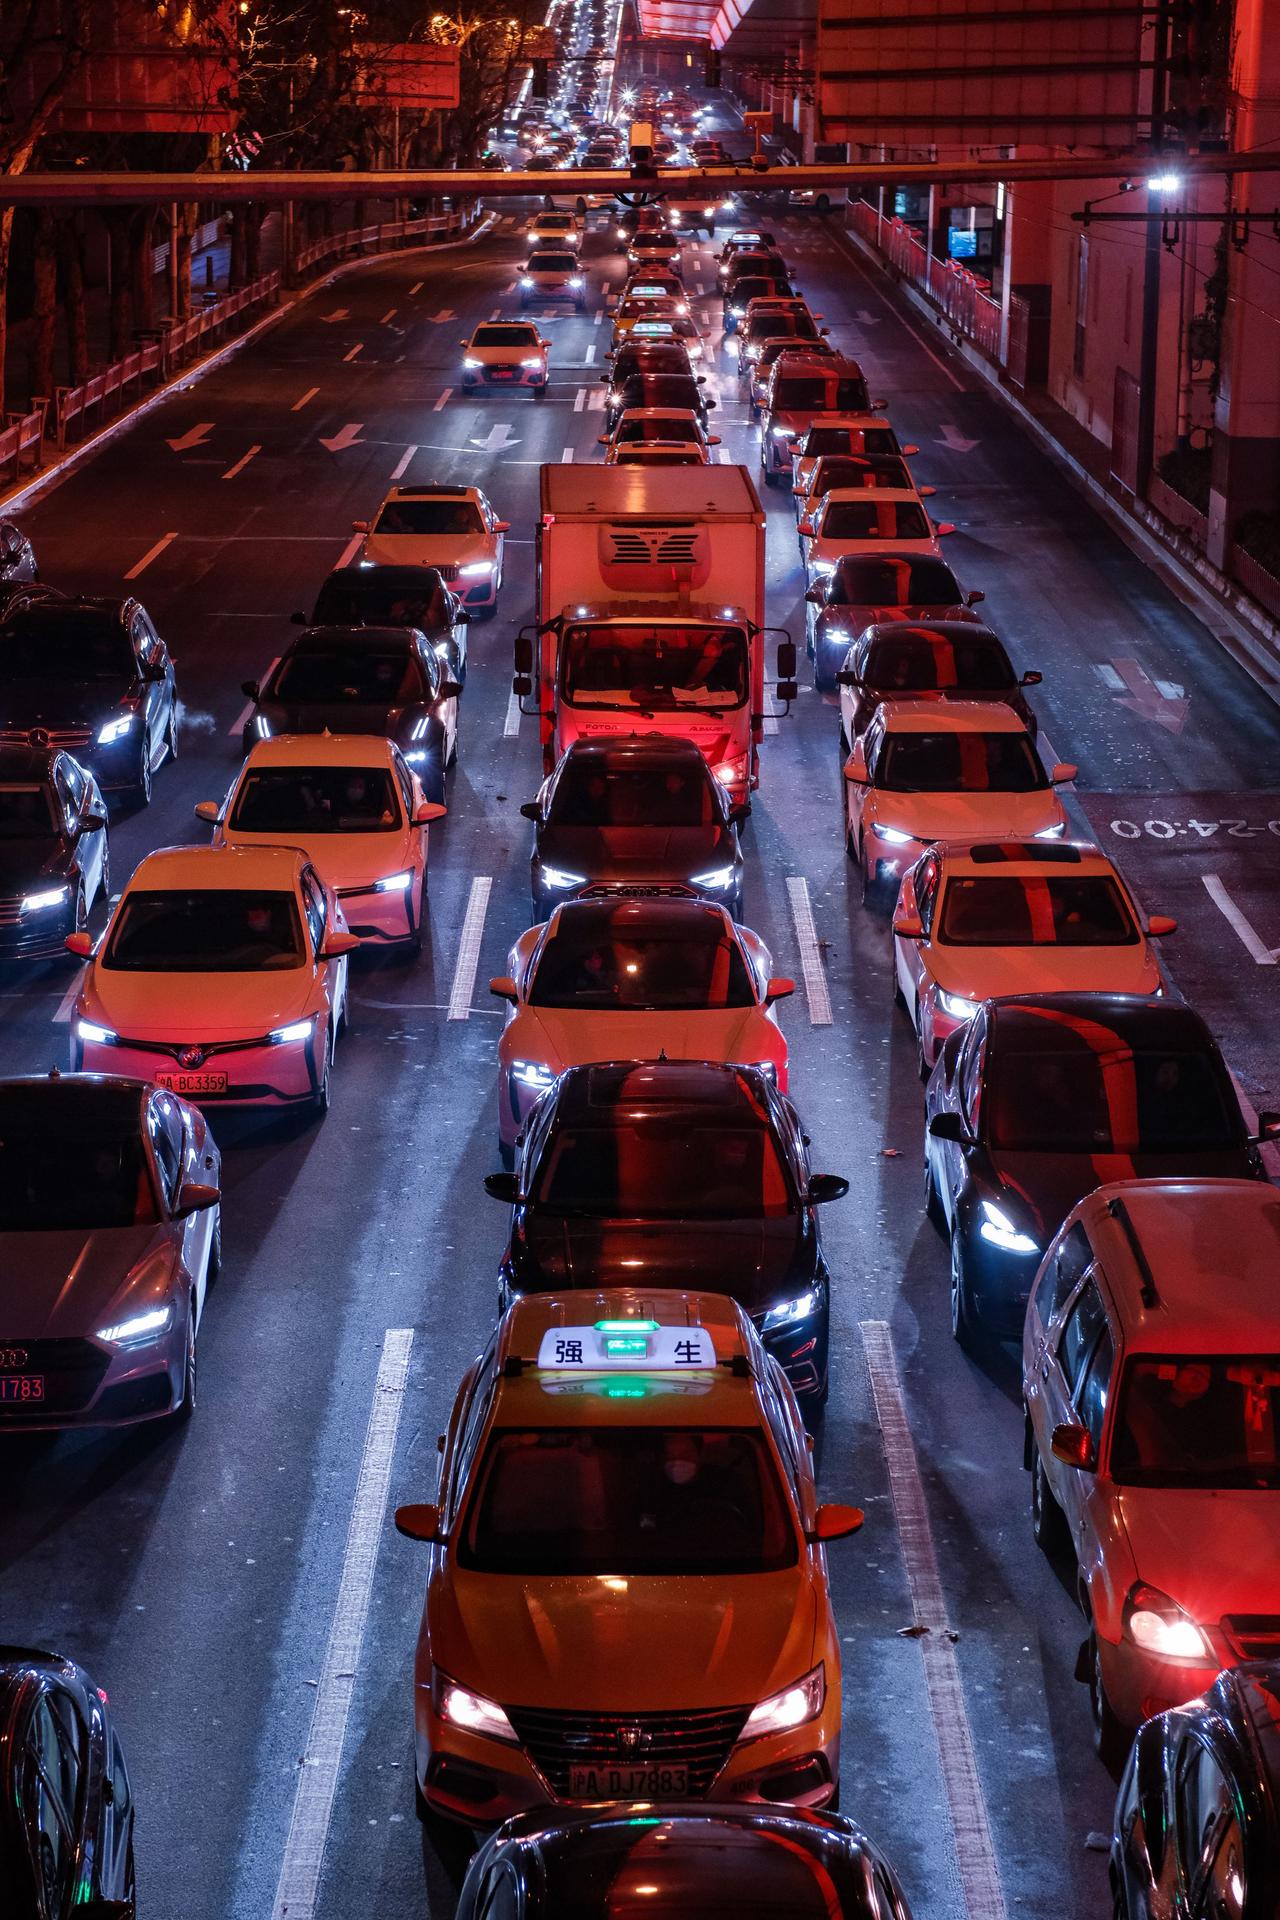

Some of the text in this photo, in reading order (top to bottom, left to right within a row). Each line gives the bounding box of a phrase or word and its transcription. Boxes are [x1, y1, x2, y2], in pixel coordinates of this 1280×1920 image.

[179, 1076, 225, 1090] BC3359
[555, 1340, 583, 1364] 强
[674, 1340, 702, 1364] 生
[608, 1770, 687, 1793] DJ7883
